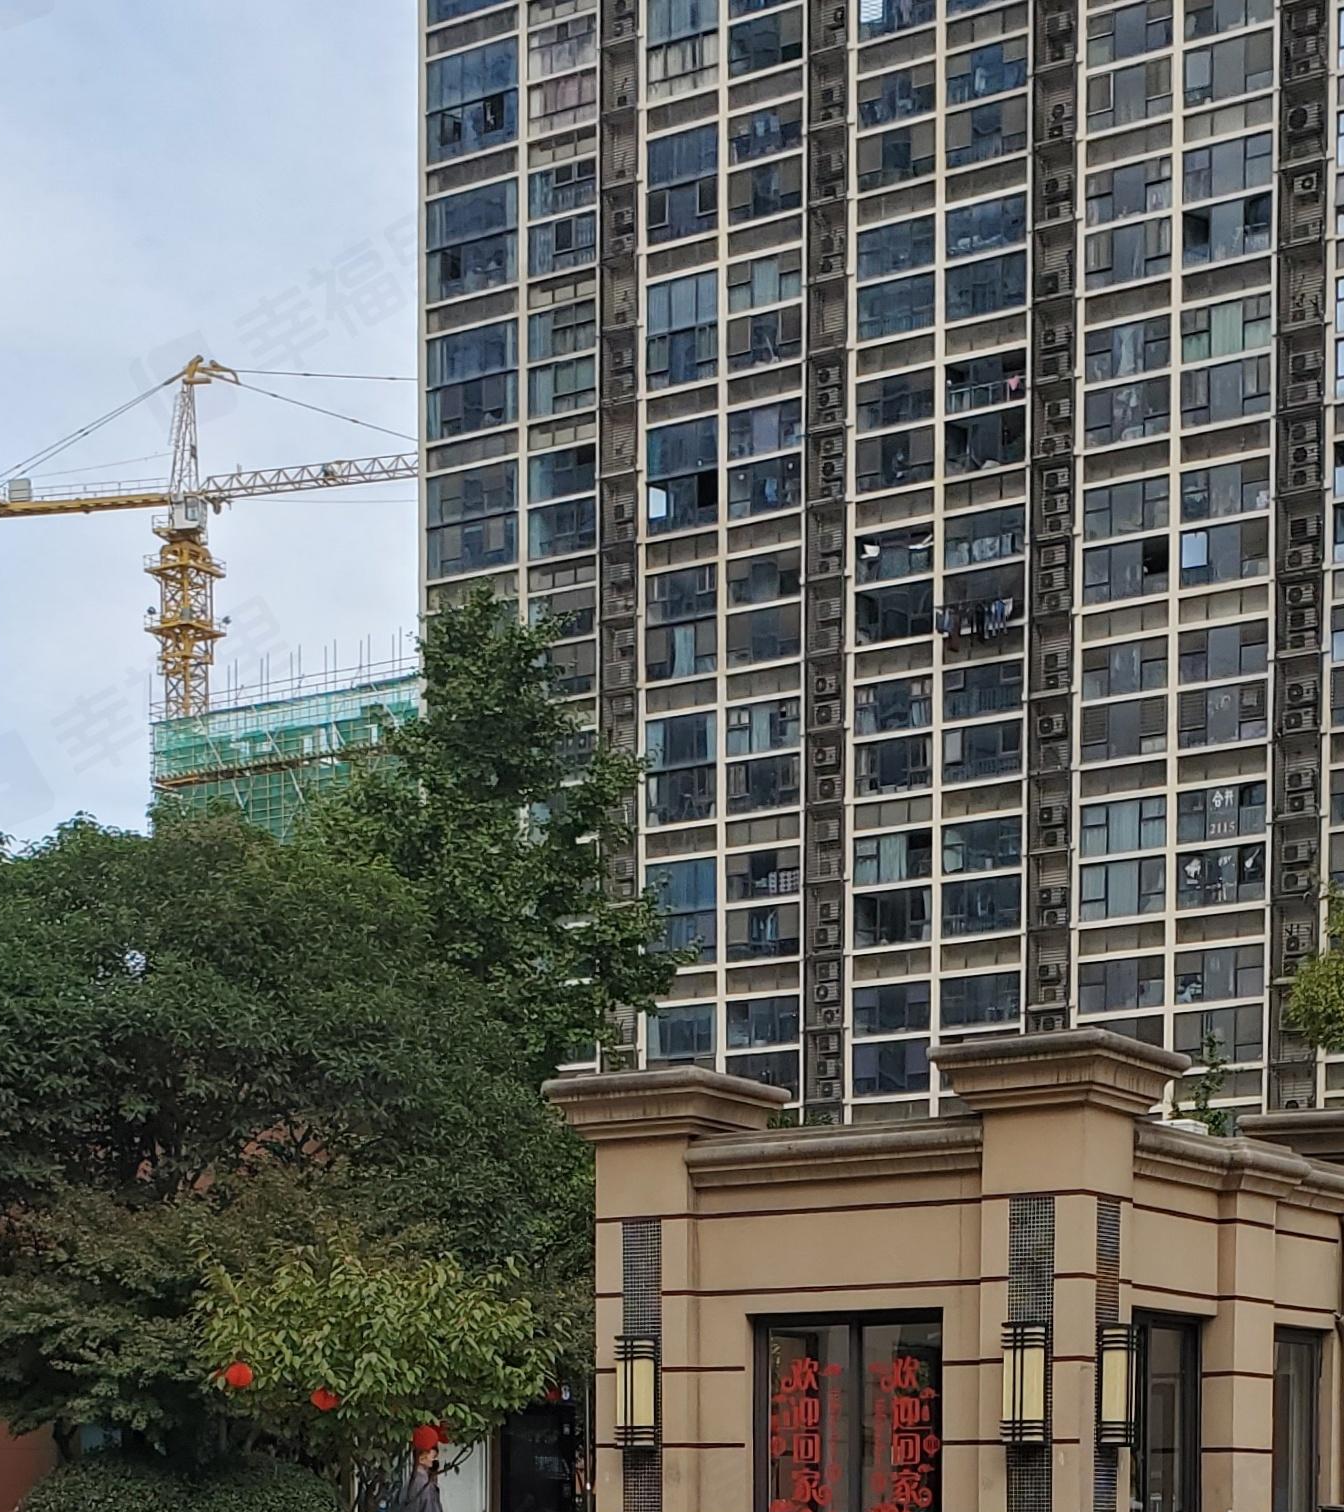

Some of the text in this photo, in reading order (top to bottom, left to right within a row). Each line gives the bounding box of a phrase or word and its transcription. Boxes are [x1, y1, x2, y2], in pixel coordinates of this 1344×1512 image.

[780, 1356, 832, 1506] 欢迎回家
[880, 1355, 934, 1508] 欢迎回家
